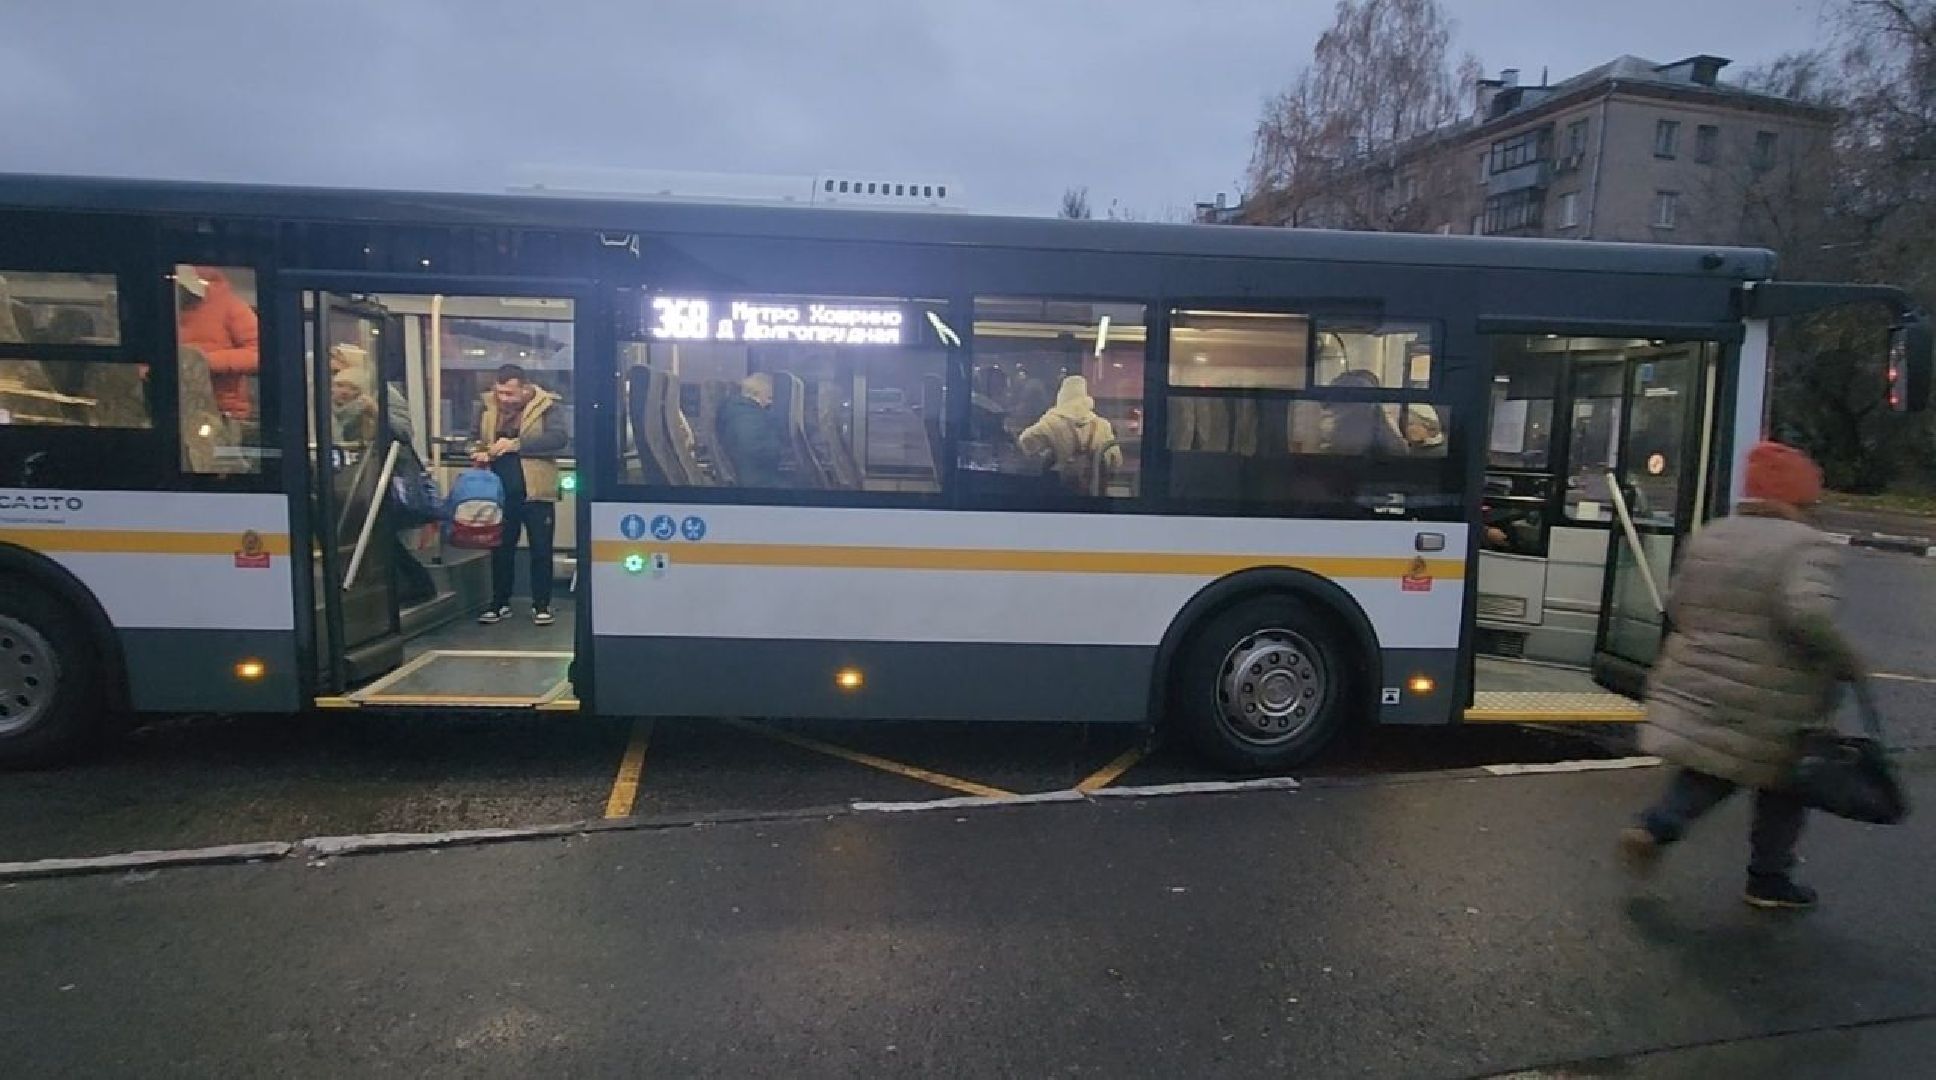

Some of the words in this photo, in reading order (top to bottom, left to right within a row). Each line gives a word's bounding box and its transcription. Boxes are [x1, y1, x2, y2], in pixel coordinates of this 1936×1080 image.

[653, 297, 708, 338] 368
[732, 302, 800, 322] Метро
[809, 304, 902, 326] Ховрино
[744, 320, 900, 343] Долгопрудная
